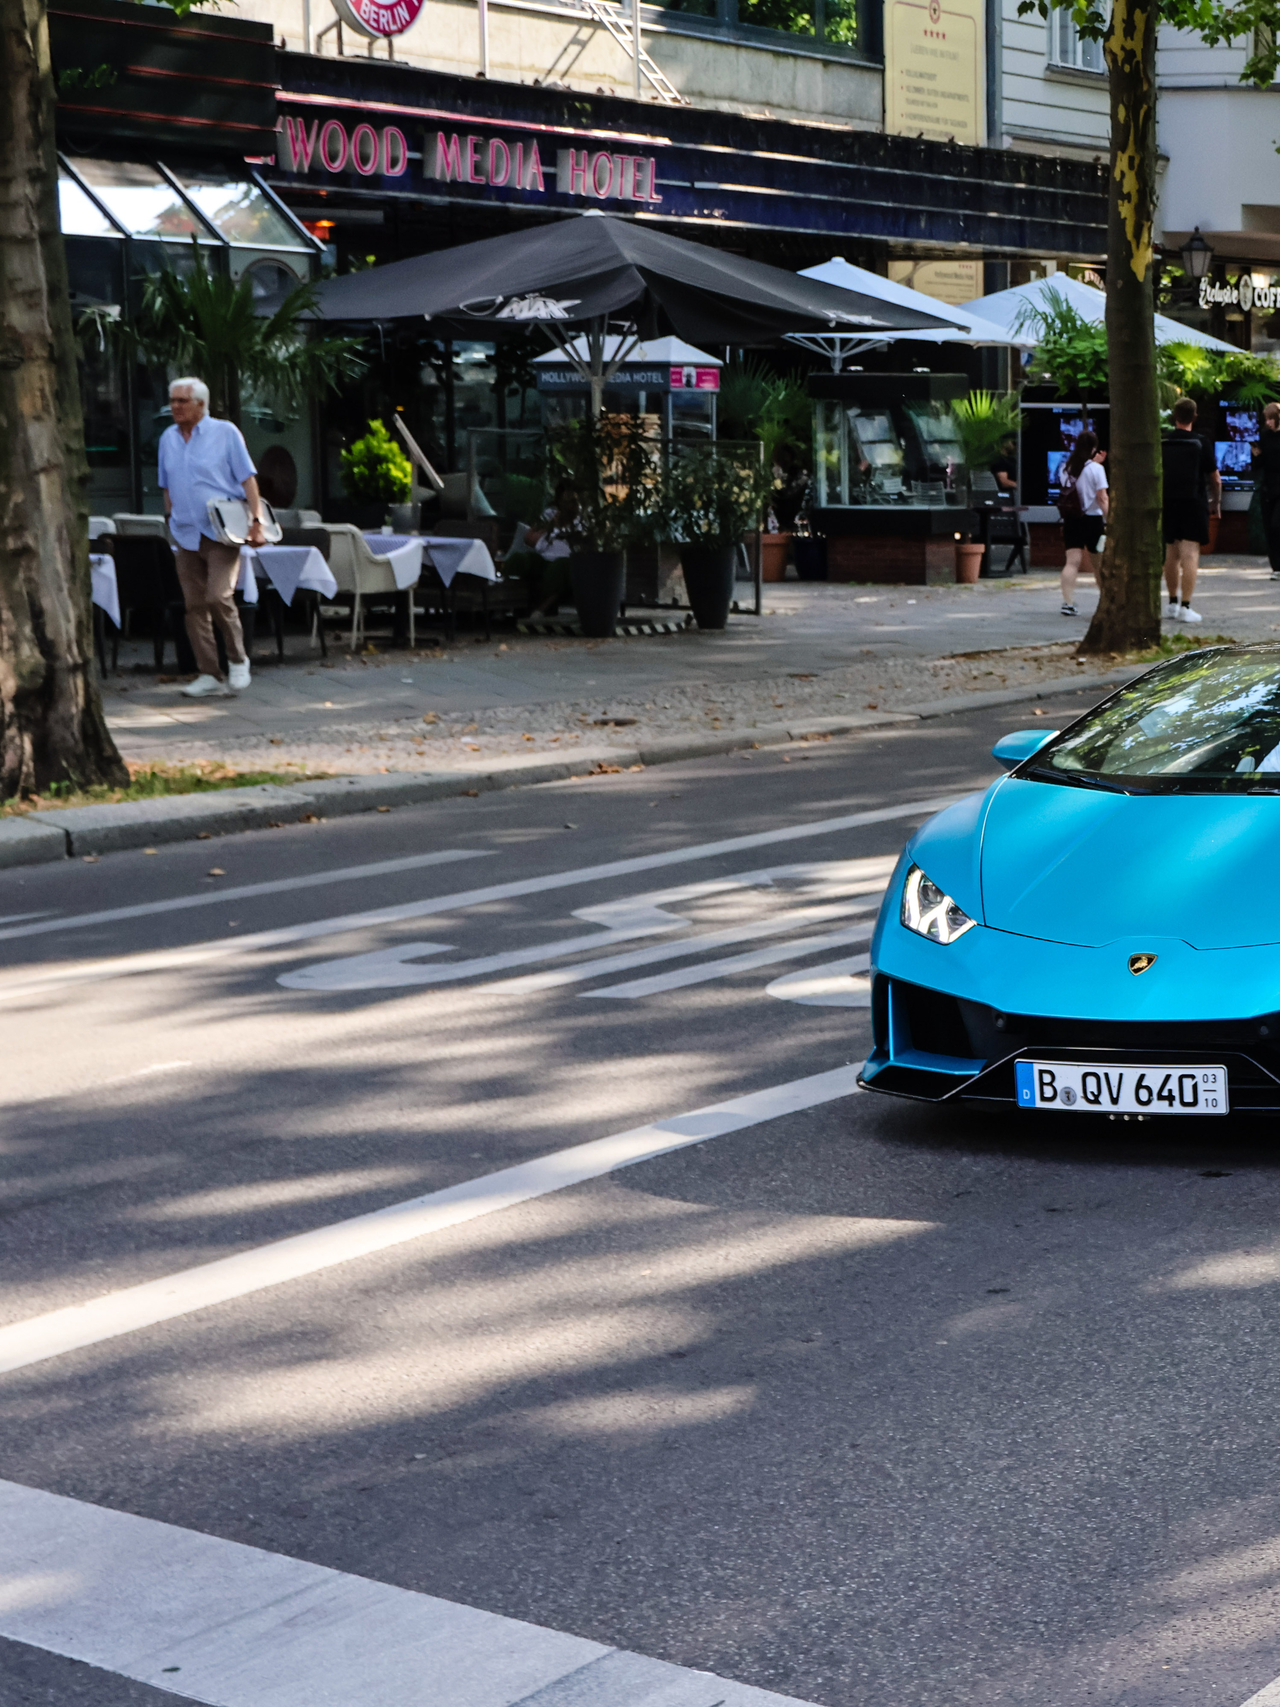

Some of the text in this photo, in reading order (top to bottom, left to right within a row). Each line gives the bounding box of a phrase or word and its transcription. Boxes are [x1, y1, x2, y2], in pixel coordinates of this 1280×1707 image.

[360, 1, 411, 32] BERLIN
[277, 116, 663, 204] WOOD MEDIA HOTEL
[541, 372, 587, 384] HOLLYWO
[606, 373, 631, 384] EDIA
[633, 373, 664, 384] HOTEL
[1202, 1073, 1217, 1084] 03
[1023, 1088, 1031, 1099] D
[1038, 1069, 1199, 1107] B QV 640
[1204, 1098, 1218, 1108] 10
